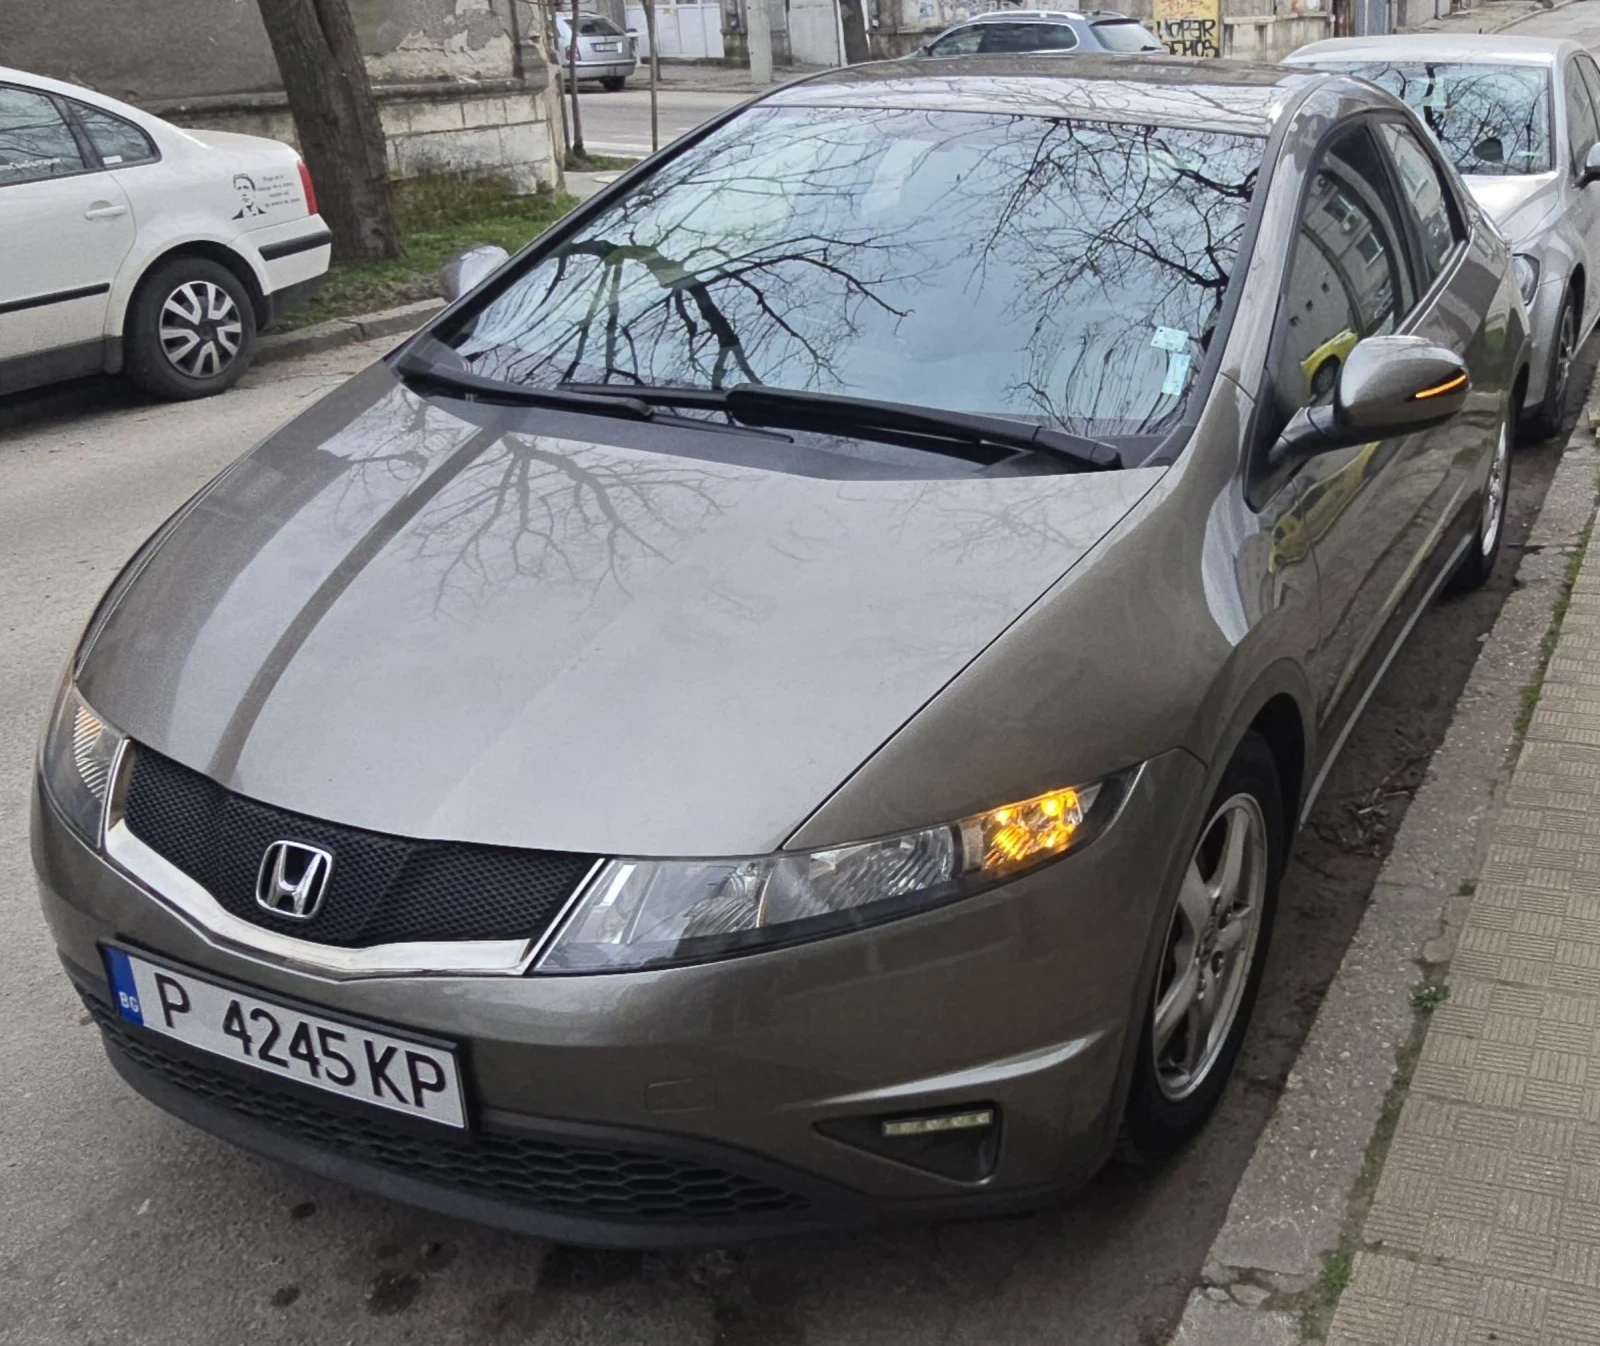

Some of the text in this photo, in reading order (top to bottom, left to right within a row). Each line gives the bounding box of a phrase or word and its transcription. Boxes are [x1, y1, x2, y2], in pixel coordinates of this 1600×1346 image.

[118, 991, 140, 1013] BG
[154, 972, 447, 1108] P 4245 KP
